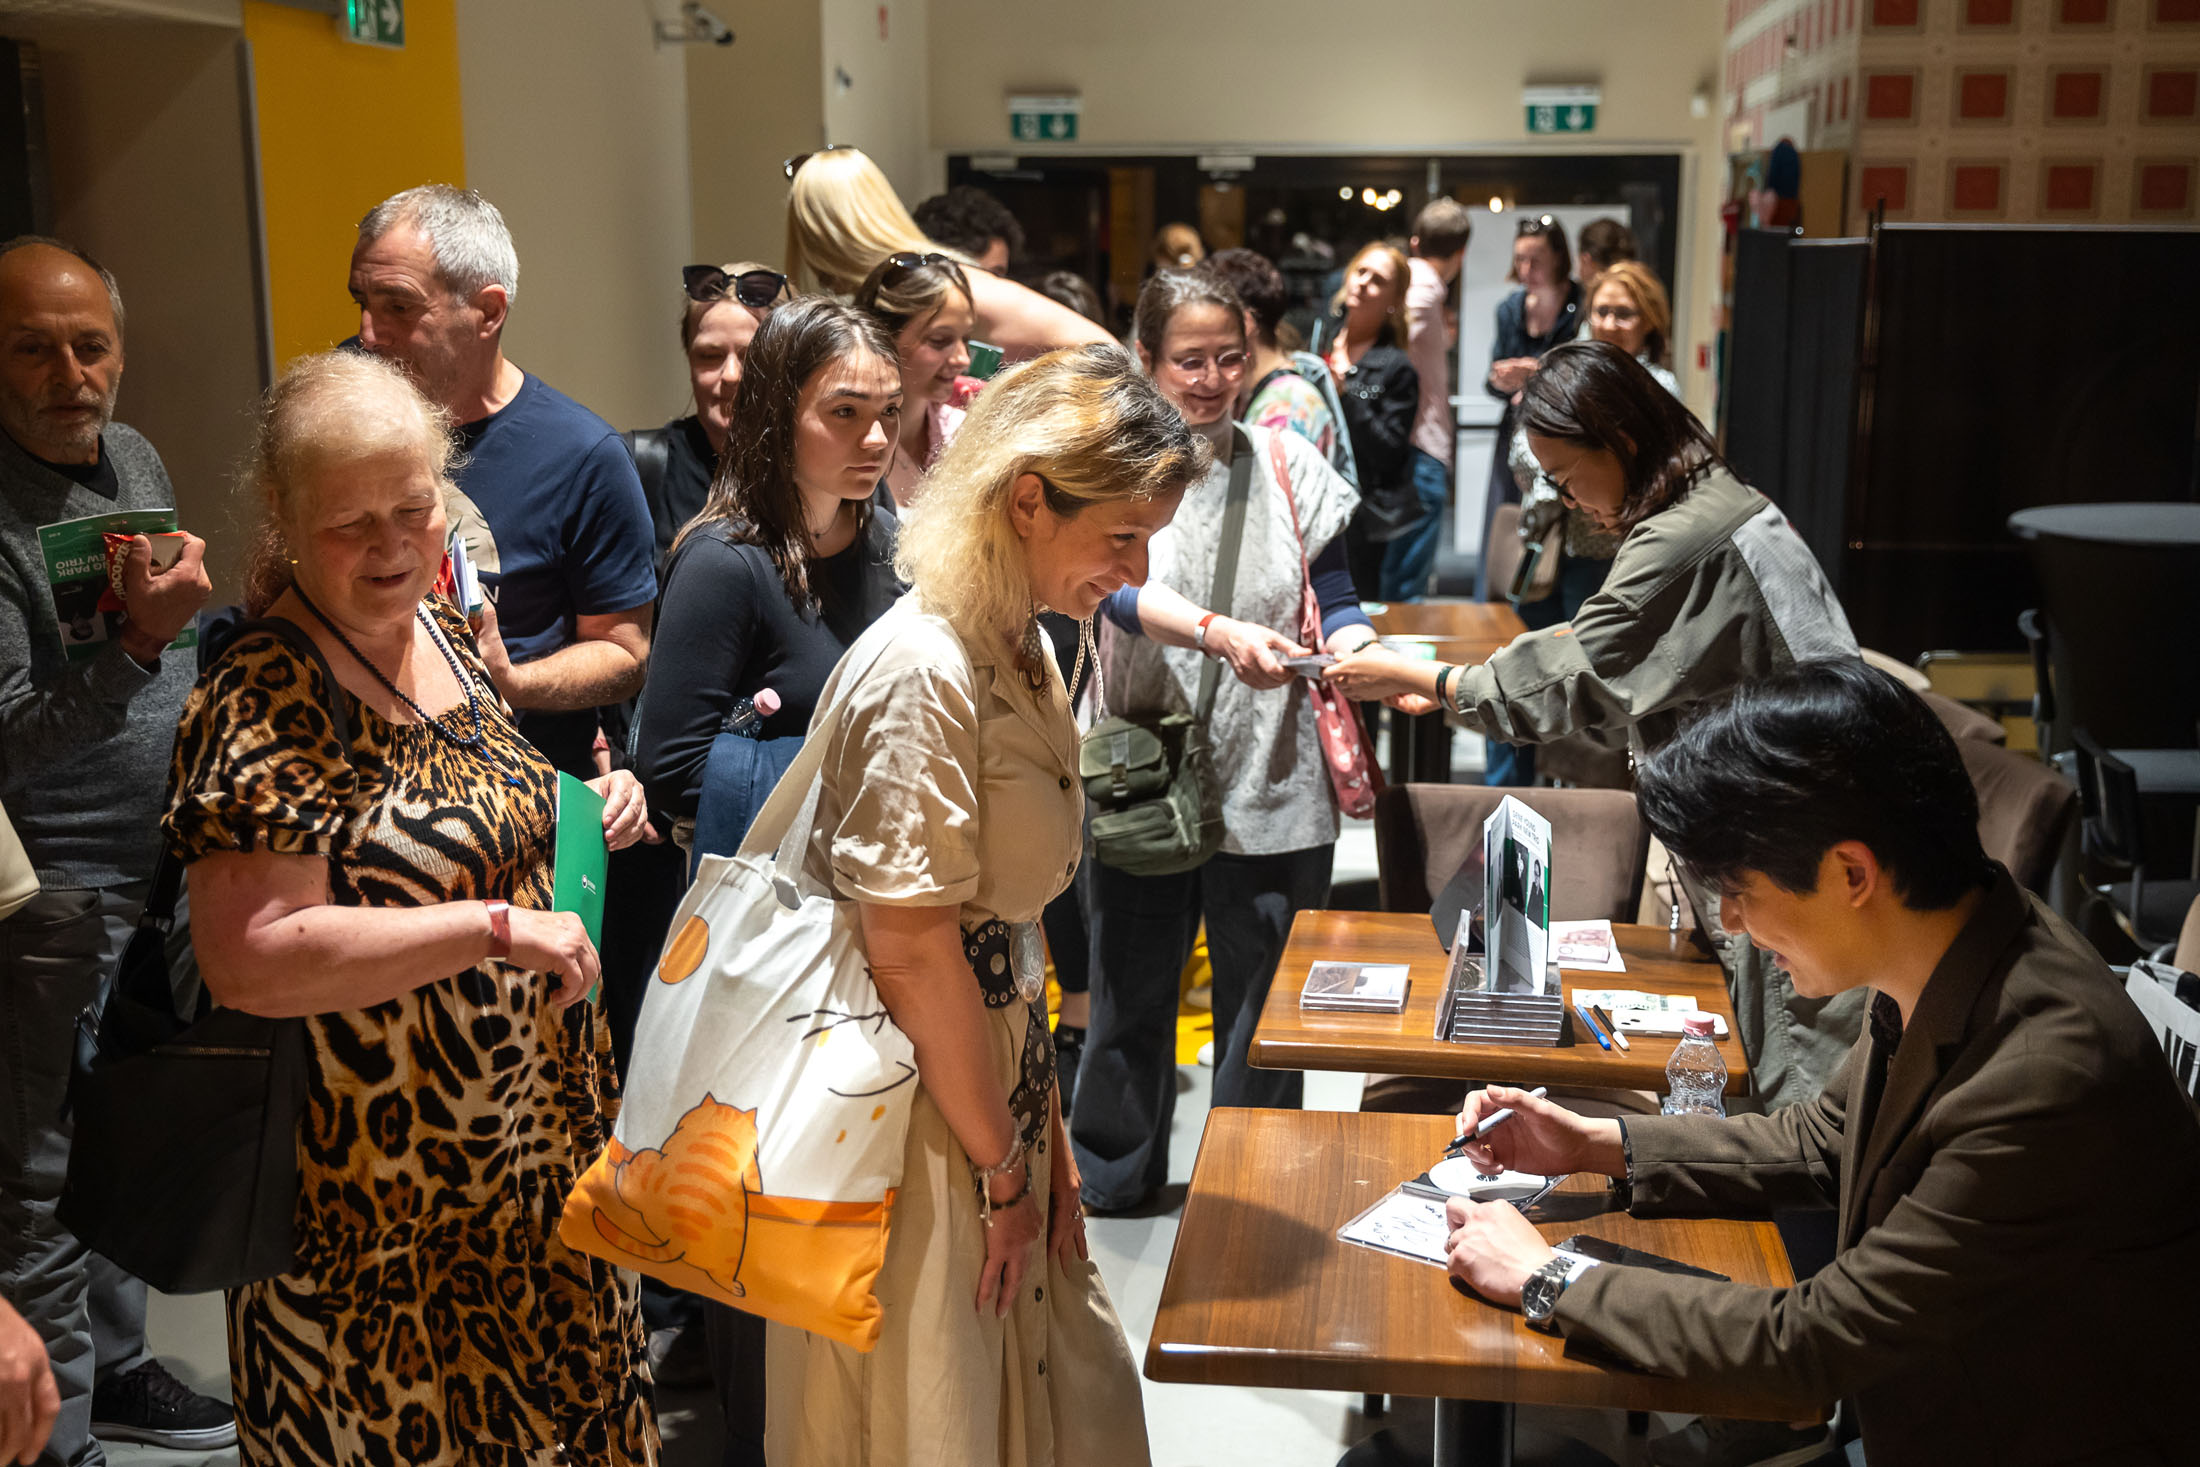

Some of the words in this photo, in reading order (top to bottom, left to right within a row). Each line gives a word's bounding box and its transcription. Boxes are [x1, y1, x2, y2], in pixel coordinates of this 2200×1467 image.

[55, 556, 85, 570] TRIO
[87, 553, 106, 564] EW
[56, 563, 92, 578] PARK
